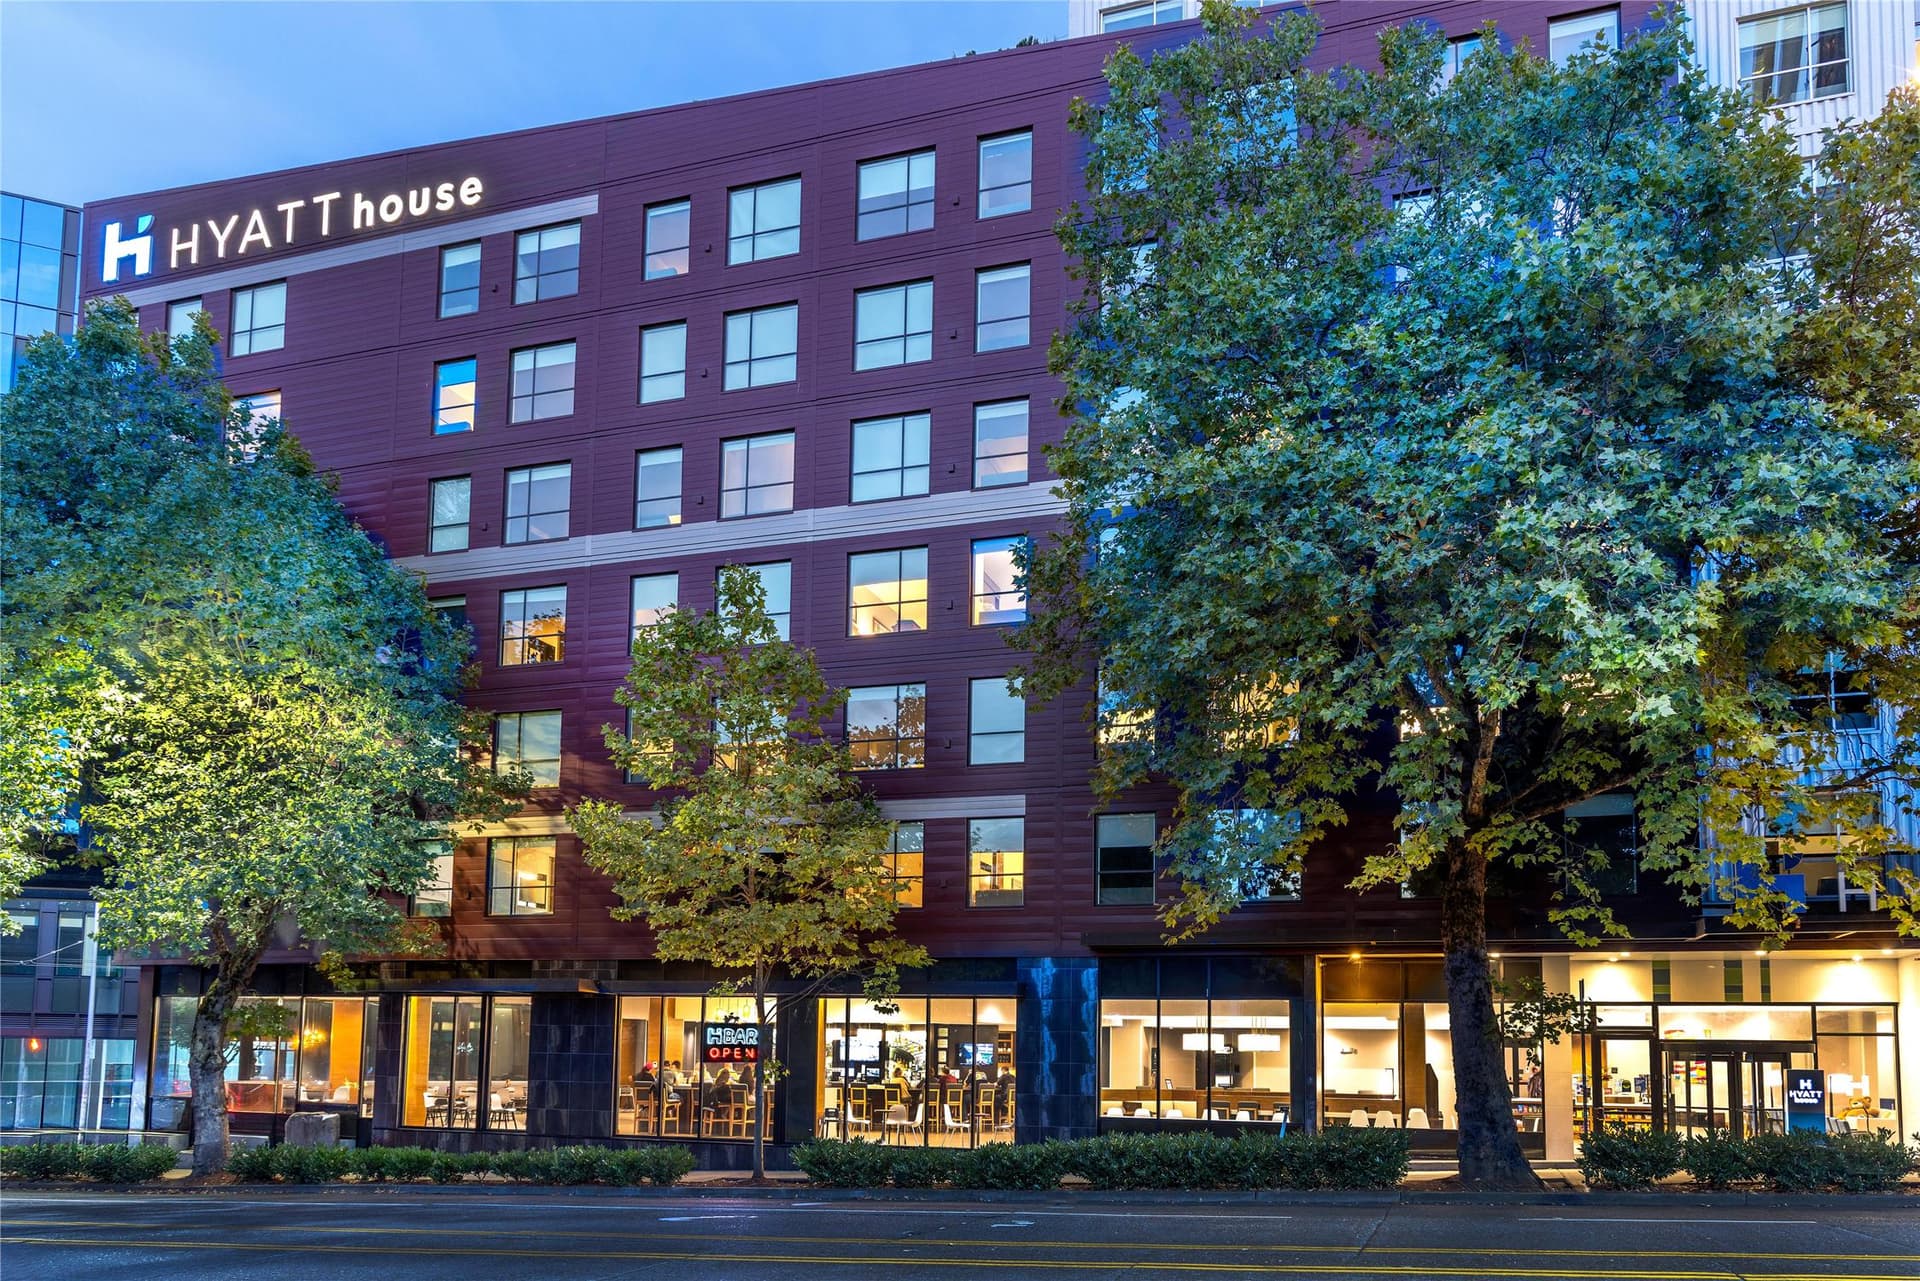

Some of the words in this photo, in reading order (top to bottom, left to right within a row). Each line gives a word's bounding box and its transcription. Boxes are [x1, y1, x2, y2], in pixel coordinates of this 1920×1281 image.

[170, 192, 341, 268] HYATT
[353, 176, 484, 229] house
[706, 1027, 759, 1045] HBAR
[709, 1047, 755, 1058] OPEN
[1789, 1090, 1822, 1098] HYATT
